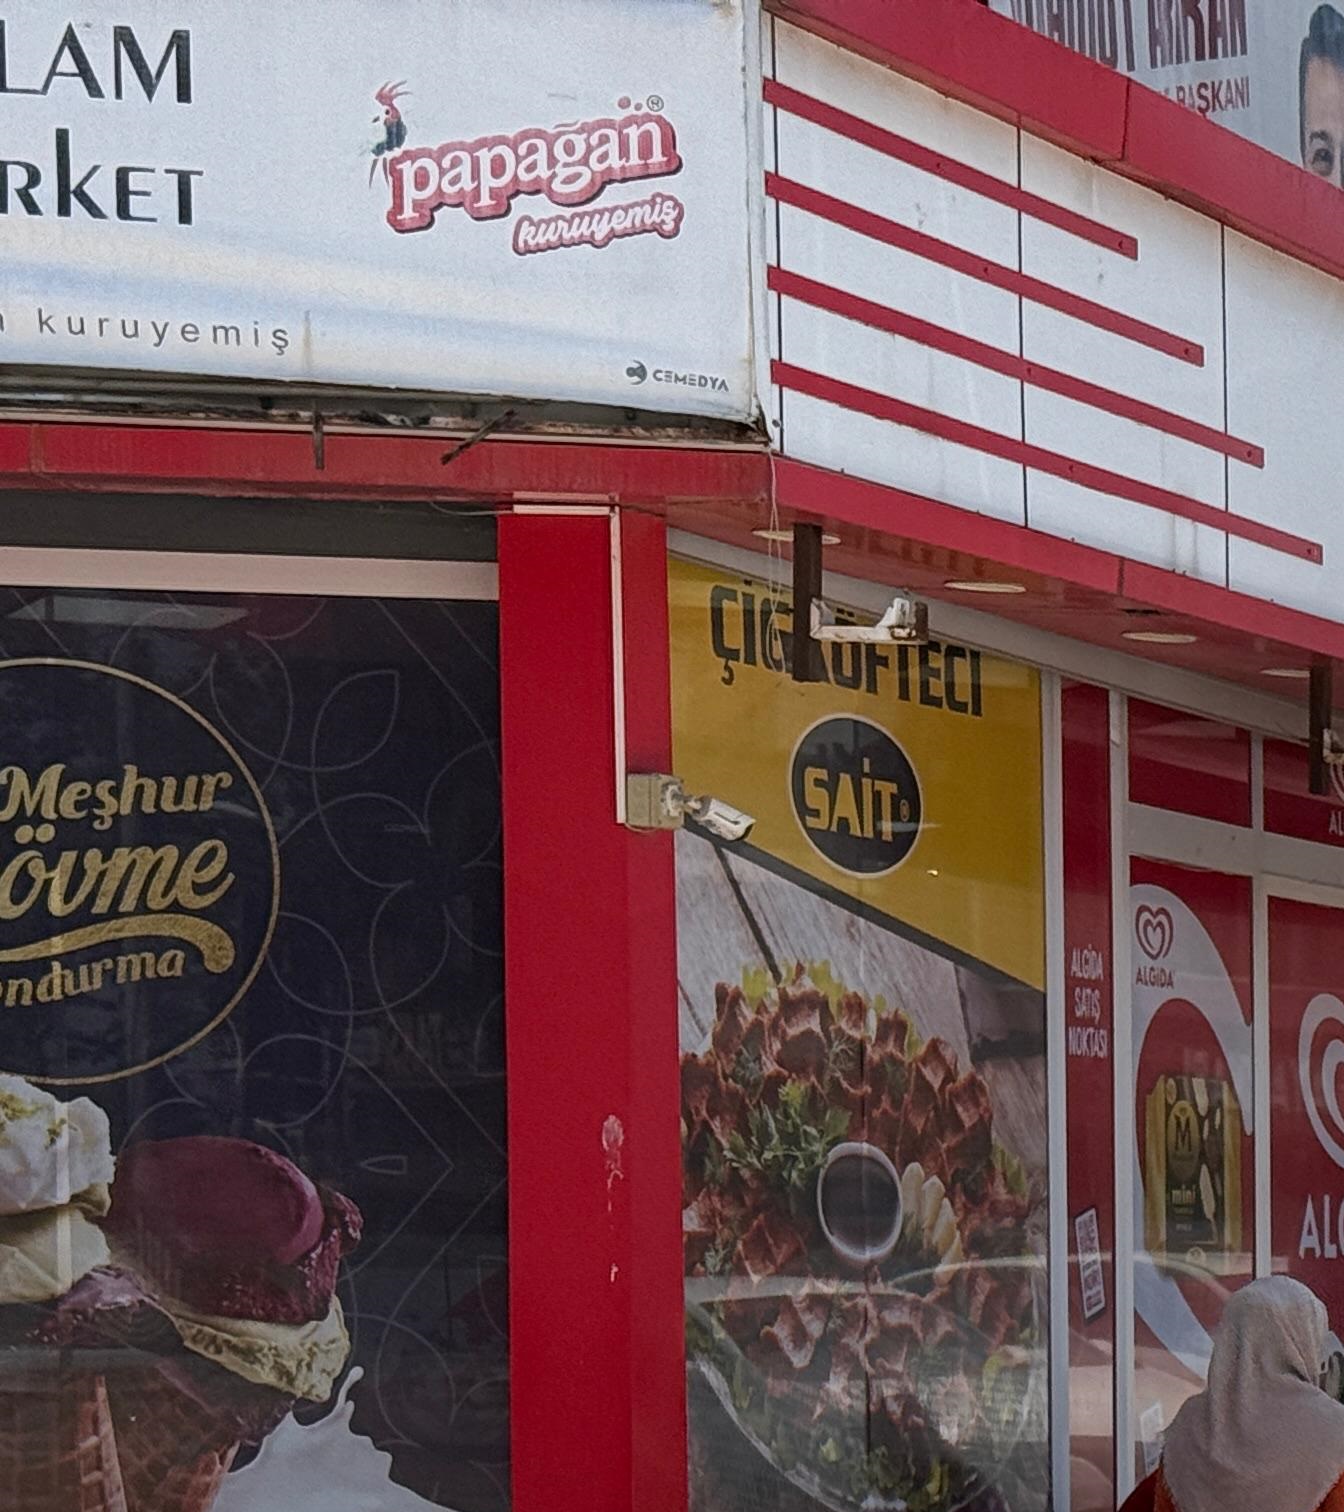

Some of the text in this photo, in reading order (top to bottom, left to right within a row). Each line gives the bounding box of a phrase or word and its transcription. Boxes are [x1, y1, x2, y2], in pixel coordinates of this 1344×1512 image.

[0, 19, 192, 104] LAM
[517, 196, 678, 250] kuruyemiş
[38, 307, 290, 355] kuruyemiş
[803, 756, 898, 843] SAİT
[0, 823, 236, 921] övme
